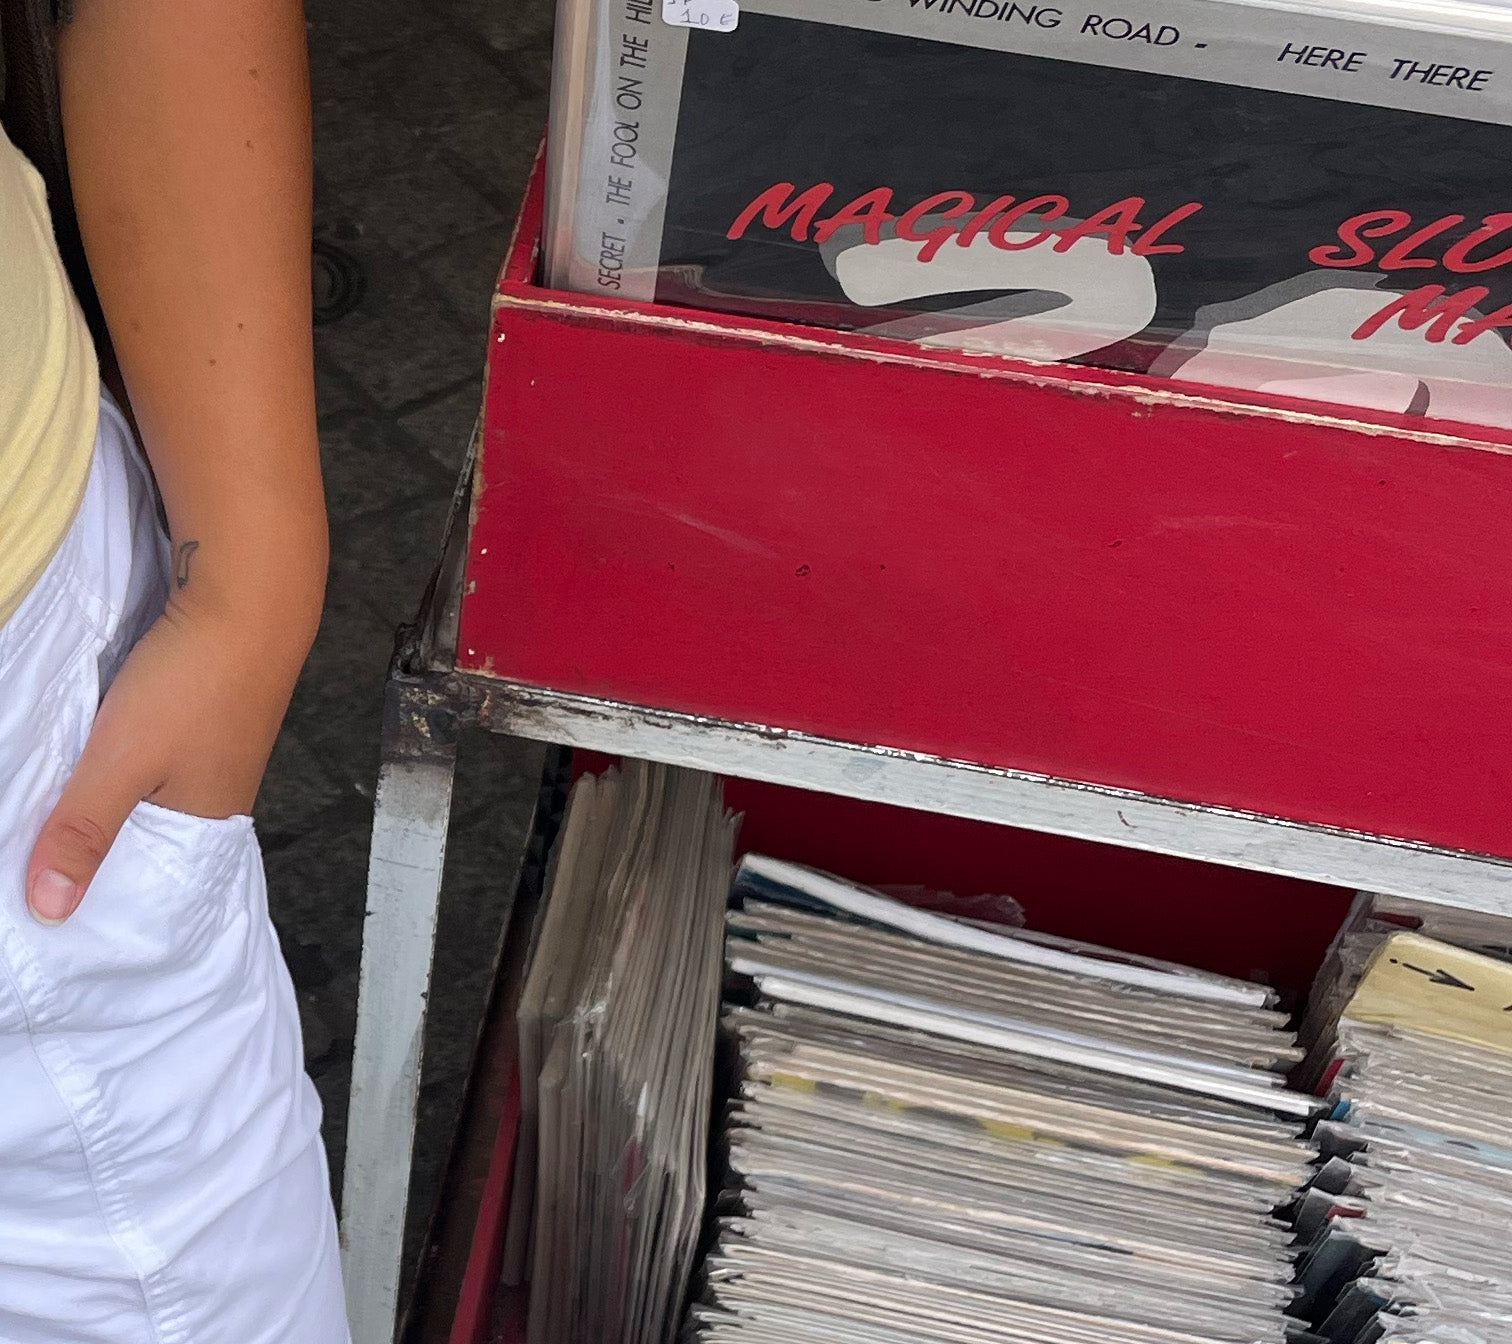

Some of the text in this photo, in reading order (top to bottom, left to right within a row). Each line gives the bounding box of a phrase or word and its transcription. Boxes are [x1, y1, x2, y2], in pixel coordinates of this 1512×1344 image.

[620, 34, 649, 69] THE
[1080, 14, 1180, 47] ROAD
[1277, 42, 1367, 72] HERE
[1390, 58, 1493, 92] THERE
[616, 76, 643, 111] ON
[610, 120, 640, 169] FOOL
[606, 175, 633, 205] THE
[726, 182, 1203, 262] MAGICAL
[598, 231, 626, 290] SECRET
